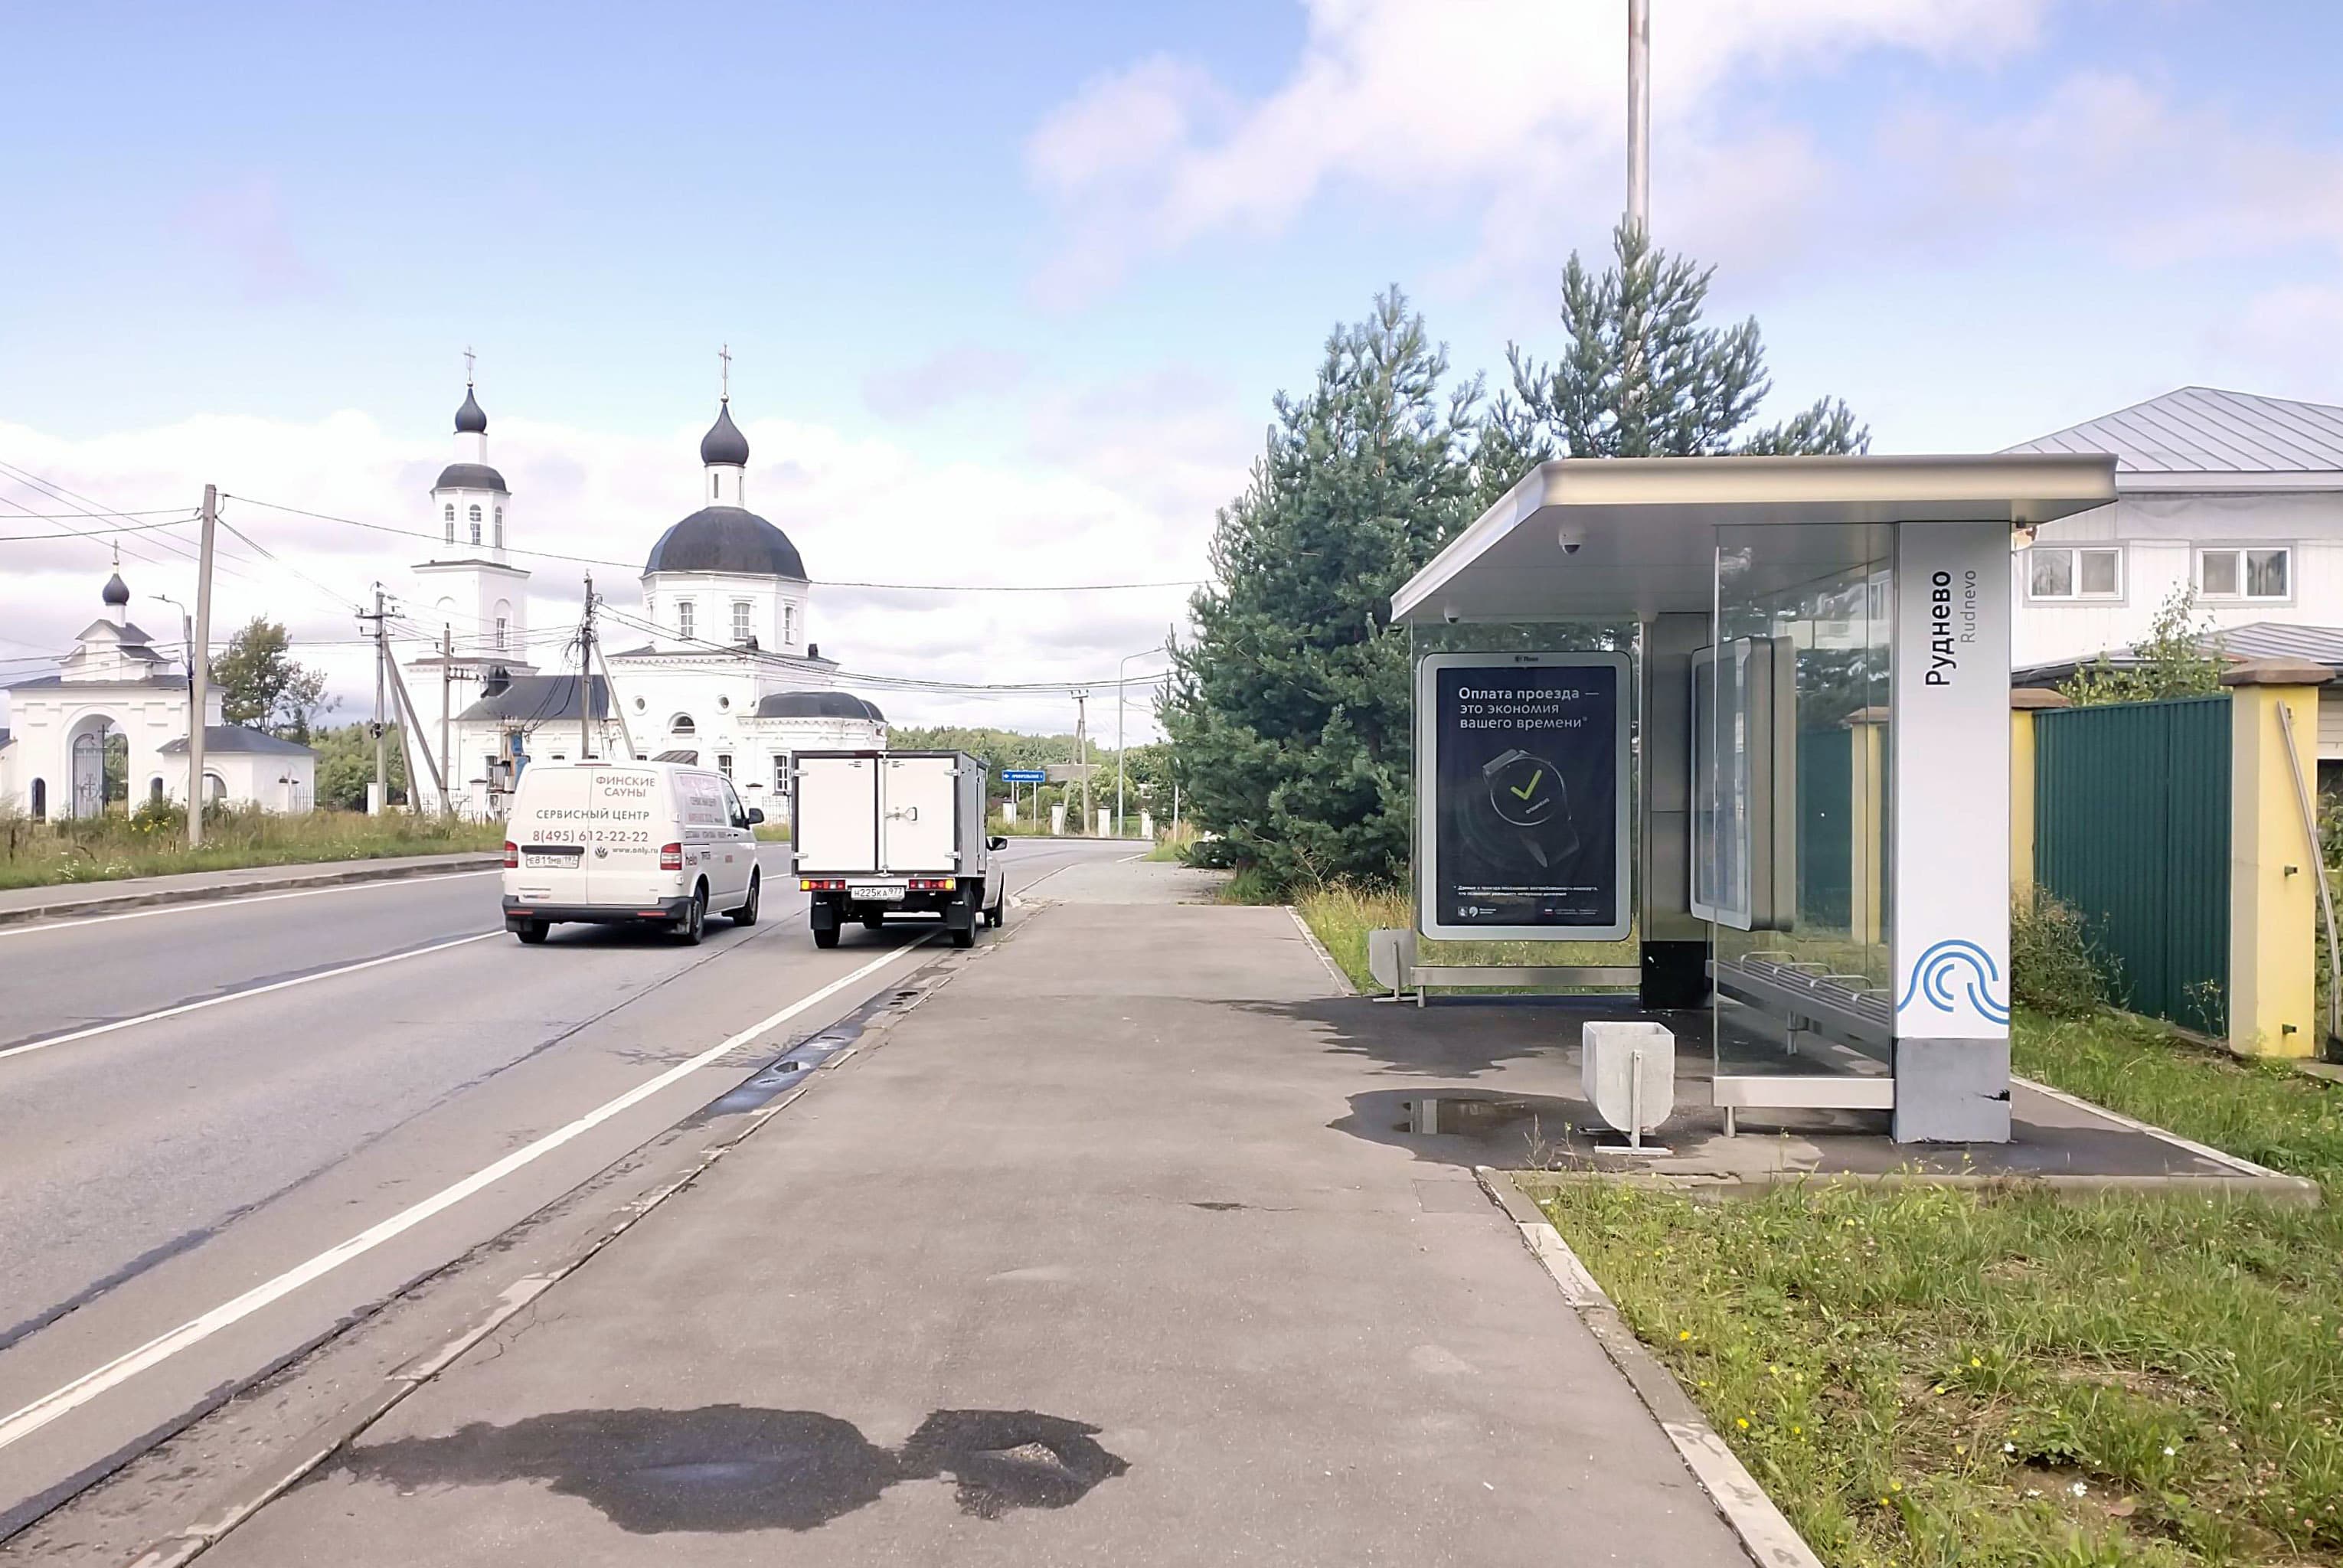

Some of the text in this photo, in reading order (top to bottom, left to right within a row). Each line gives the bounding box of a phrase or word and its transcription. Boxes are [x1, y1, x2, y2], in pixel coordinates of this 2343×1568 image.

[1960, 570, 1976, 642] Rudnevo
[1925, 571, 1956, 685] Руднево
[1459, 687, 1512, 699] Оплата
[1517, 689, 1580, 702] проезда
[1460, 704, 1559, 714] это экономия
[1460, 719, 1511, 728] вашего
[596, 776, 655, 787] ФИНСКИЕ
[604, 787, 645, 797] САУНЫ
[536, 808, 650, 821] СЕРВИСНЫЙ ЦЕНТР
[533, 830, 649, 843] 8(495) 612-22-22
[613, 846, 658, 855] www.only.ru
